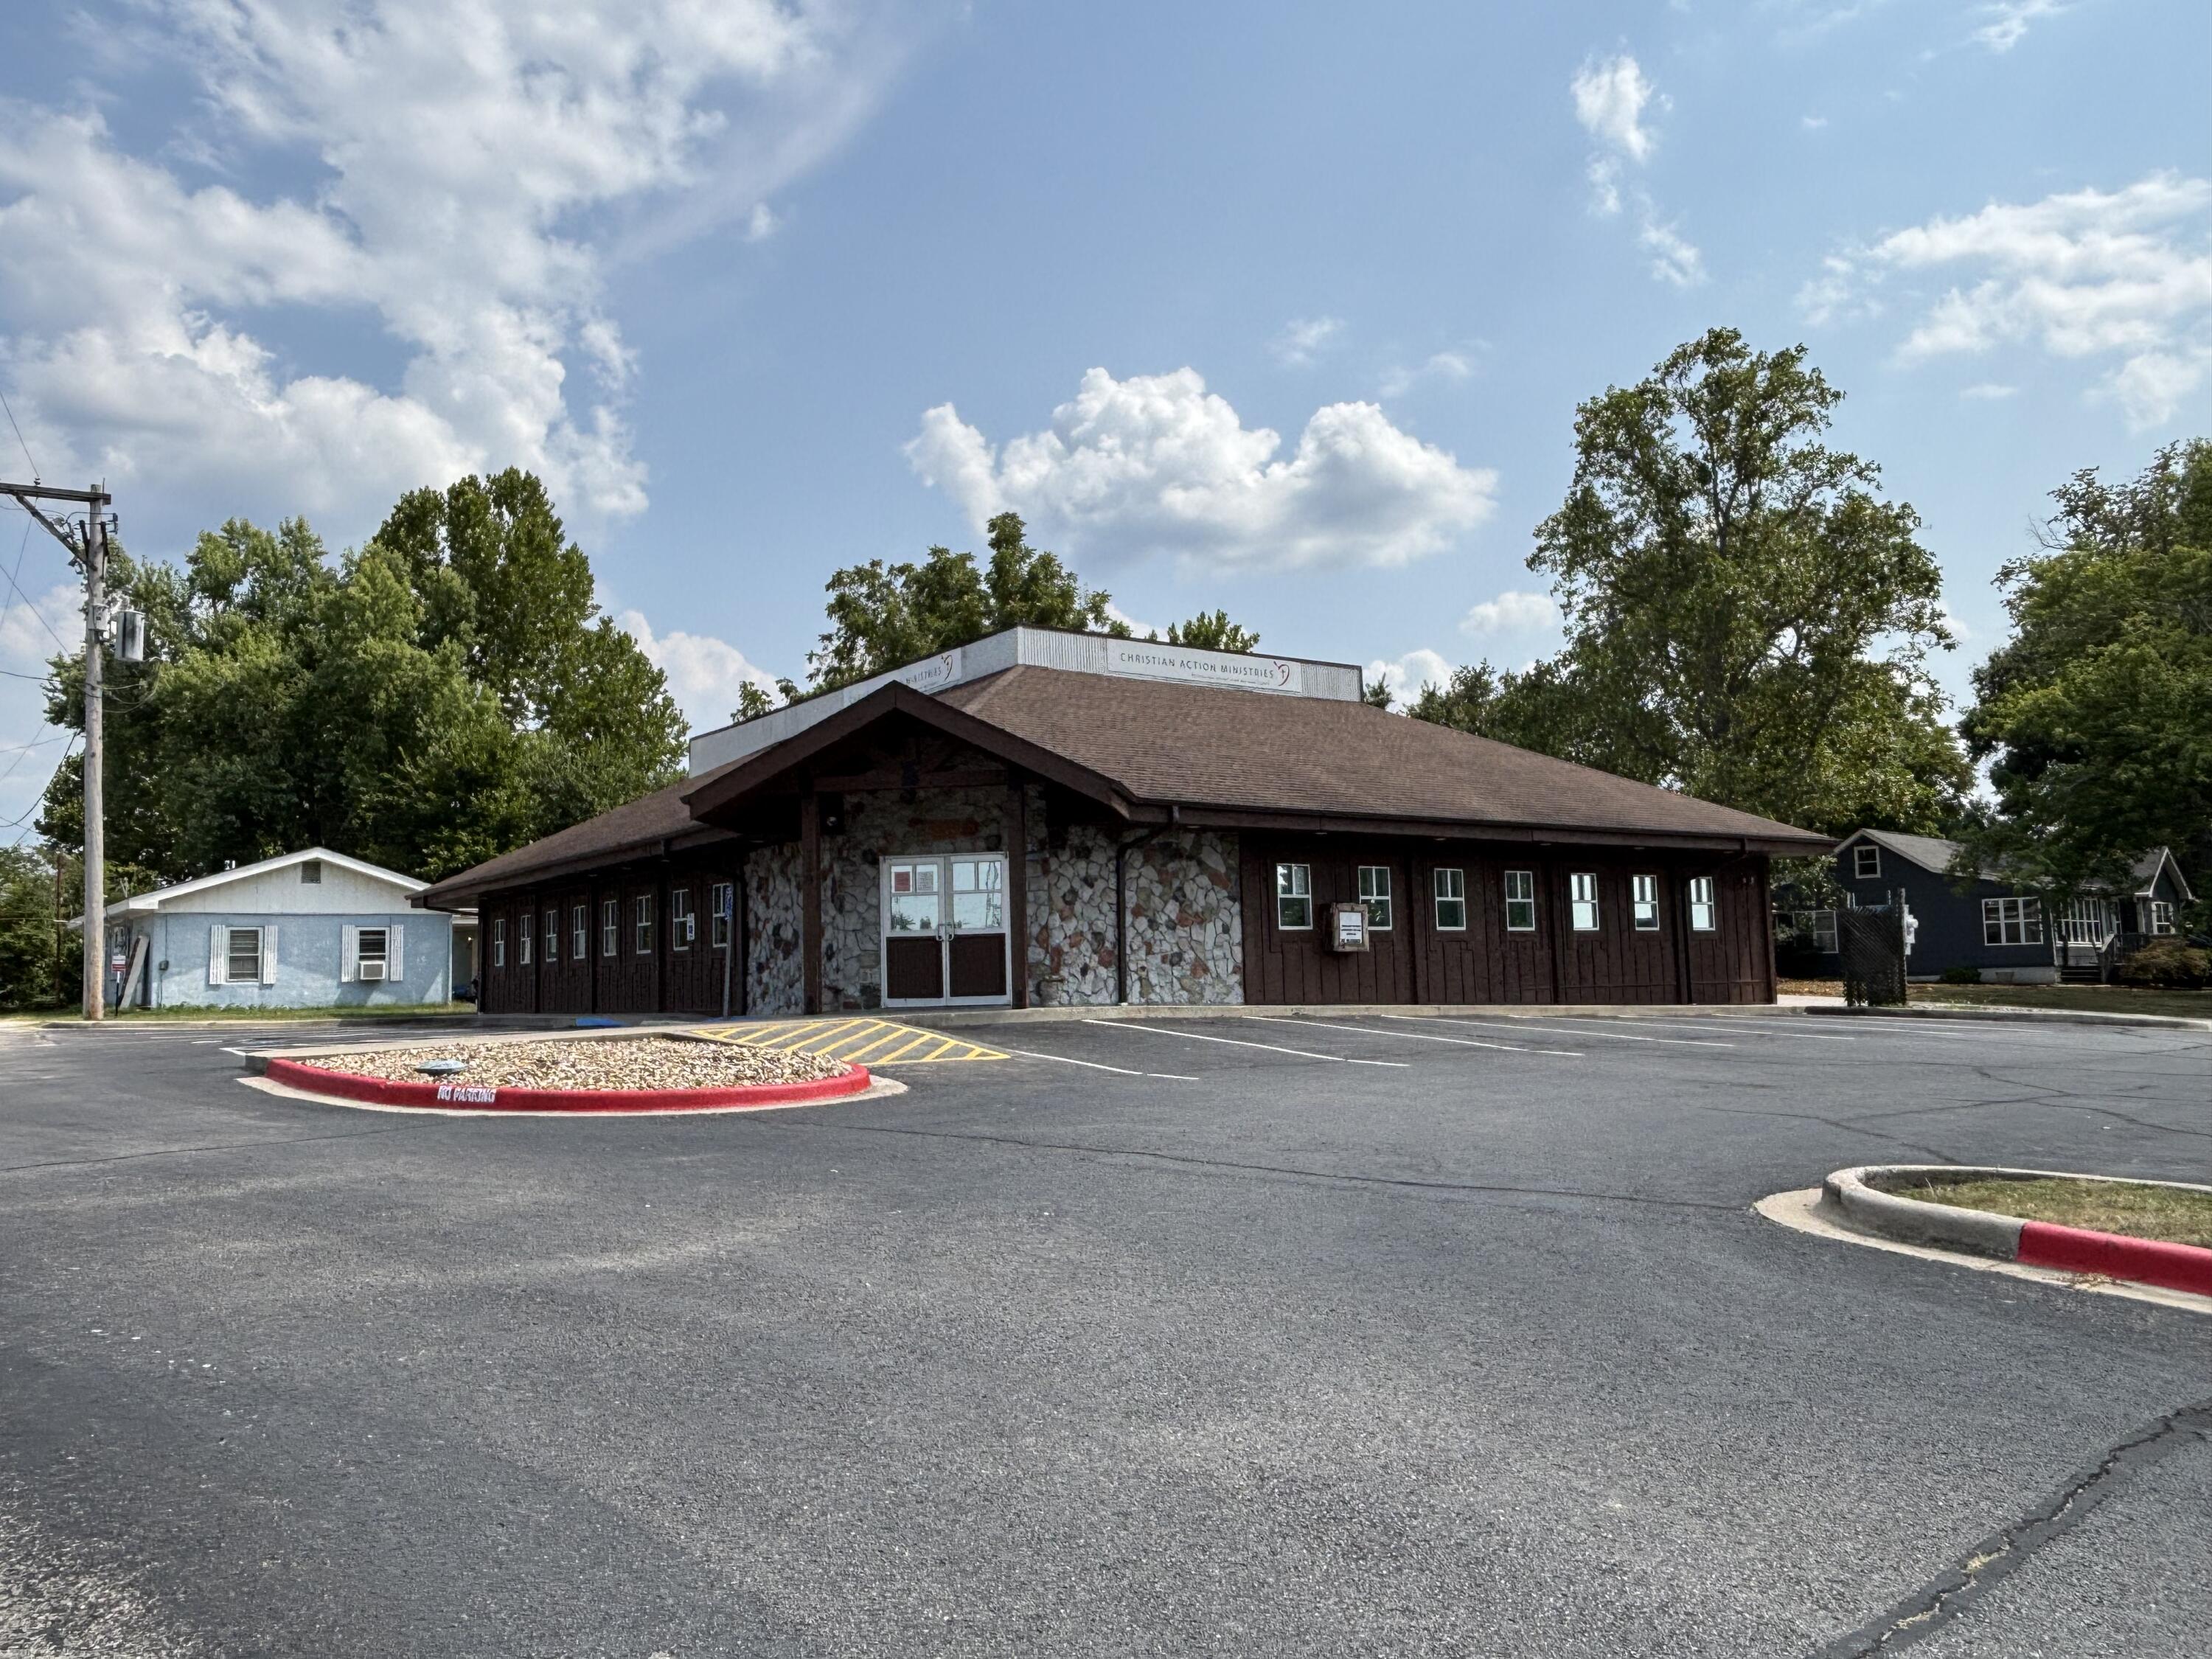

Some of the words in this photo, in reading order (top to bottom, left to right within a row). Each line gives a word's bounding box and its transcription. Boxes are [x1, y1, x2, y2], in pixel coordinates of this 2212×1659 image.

[1120, 653, 1175, 667] CHRISTIAN
[1180, 659, 1217, 672] ACTION
[1220, 664, 1274, 679] MINISTRIES
[437, 1085, 452, 1101] NO
[453, 1087, 497, 1103] PARKING
